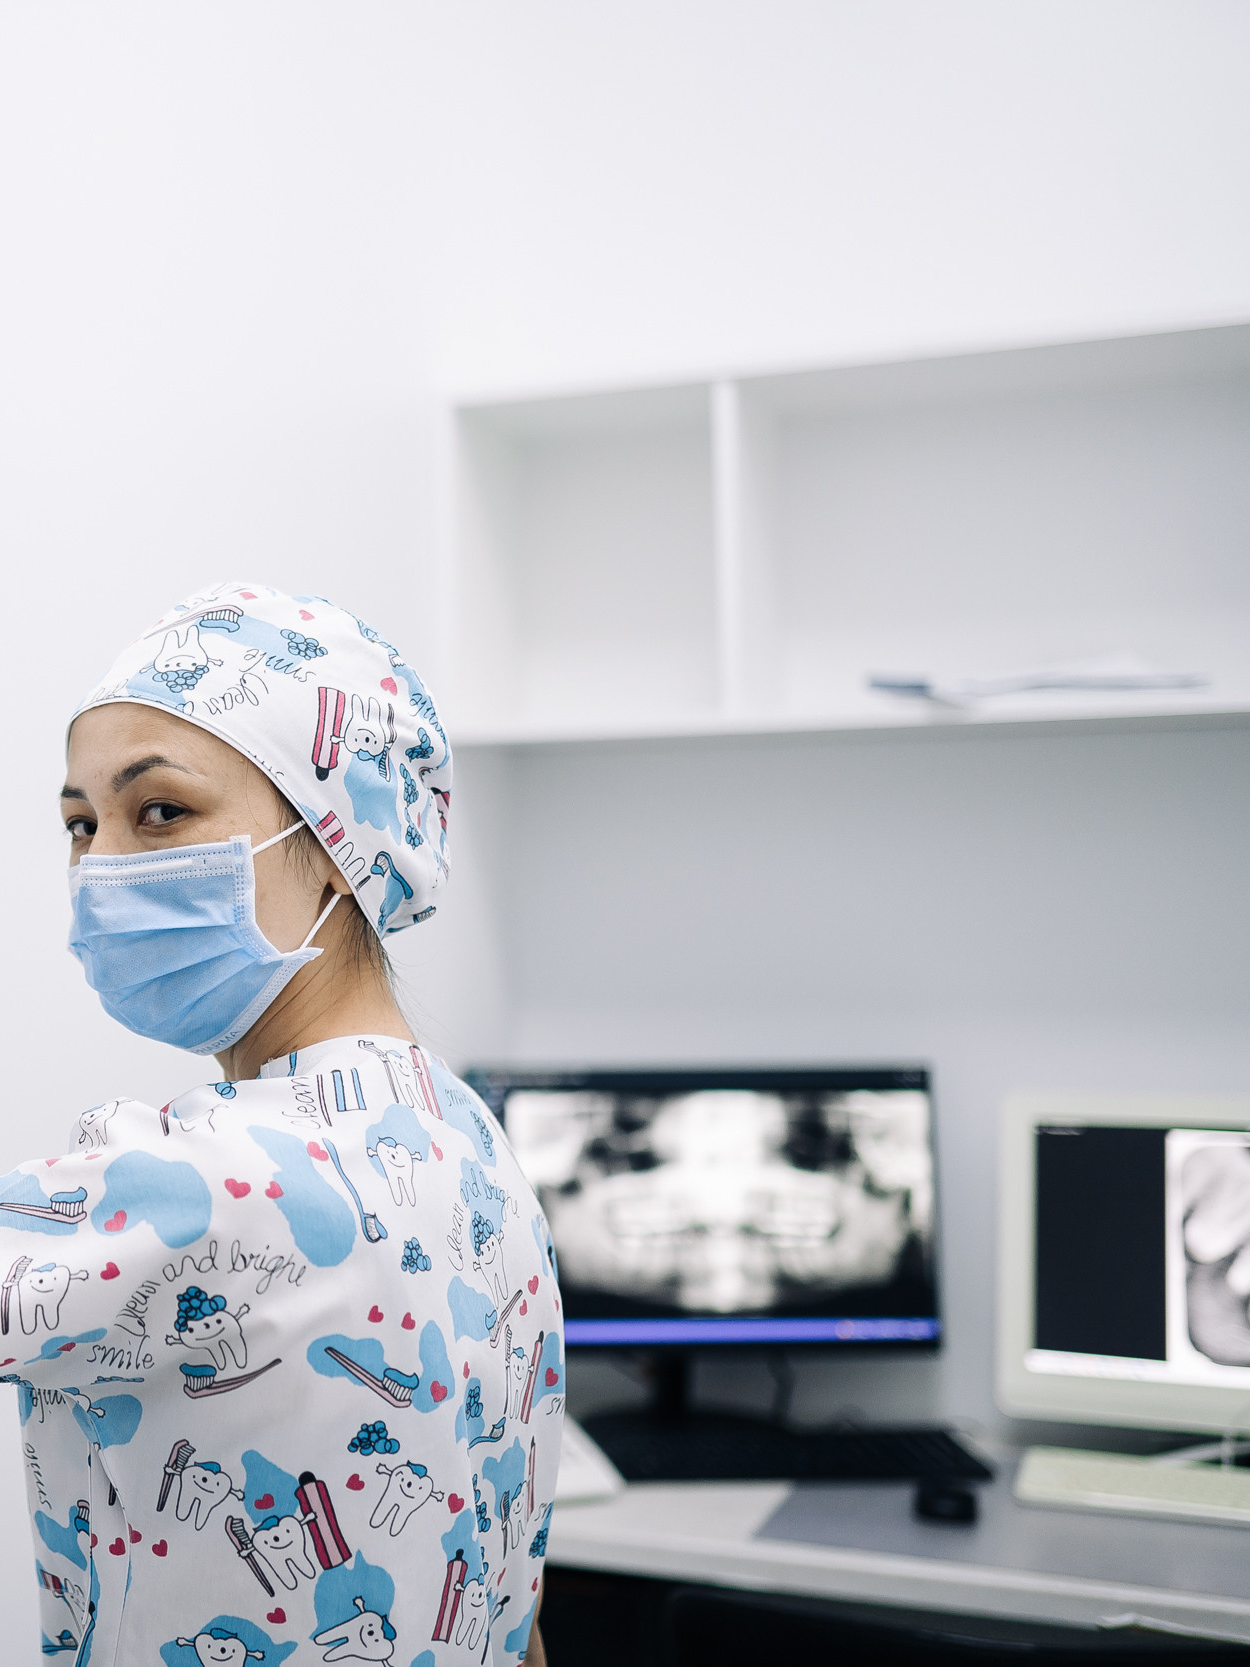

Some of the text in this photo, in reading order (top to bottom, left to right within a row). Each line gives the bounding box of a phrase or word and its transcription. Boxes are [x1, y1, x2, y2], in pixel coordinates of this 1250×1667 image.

[239, 648, 317, 683] smile
[162, 1240, 219, 1283] and
[86, 1335, 155, 1371] smile
